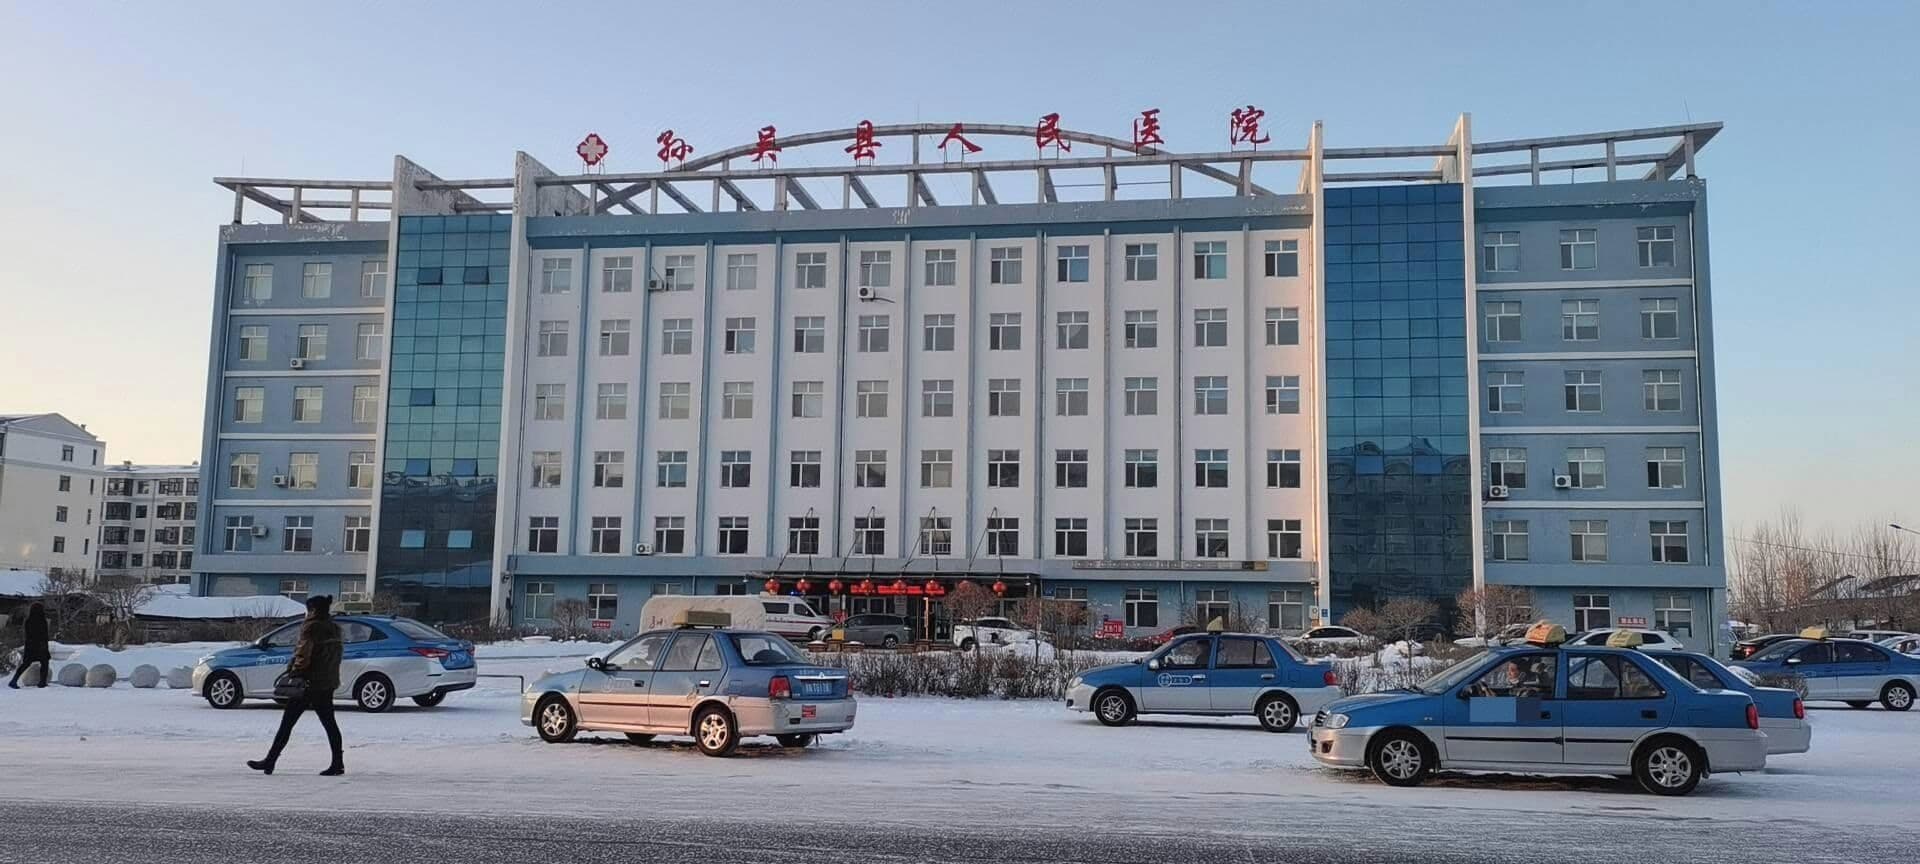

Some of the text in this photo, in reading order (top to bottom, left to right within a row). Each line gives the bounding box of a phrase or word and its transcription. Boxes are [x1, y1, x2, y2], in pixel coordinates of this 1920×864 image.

[656, 104, 1271, 163] 孙吴县人民医院
